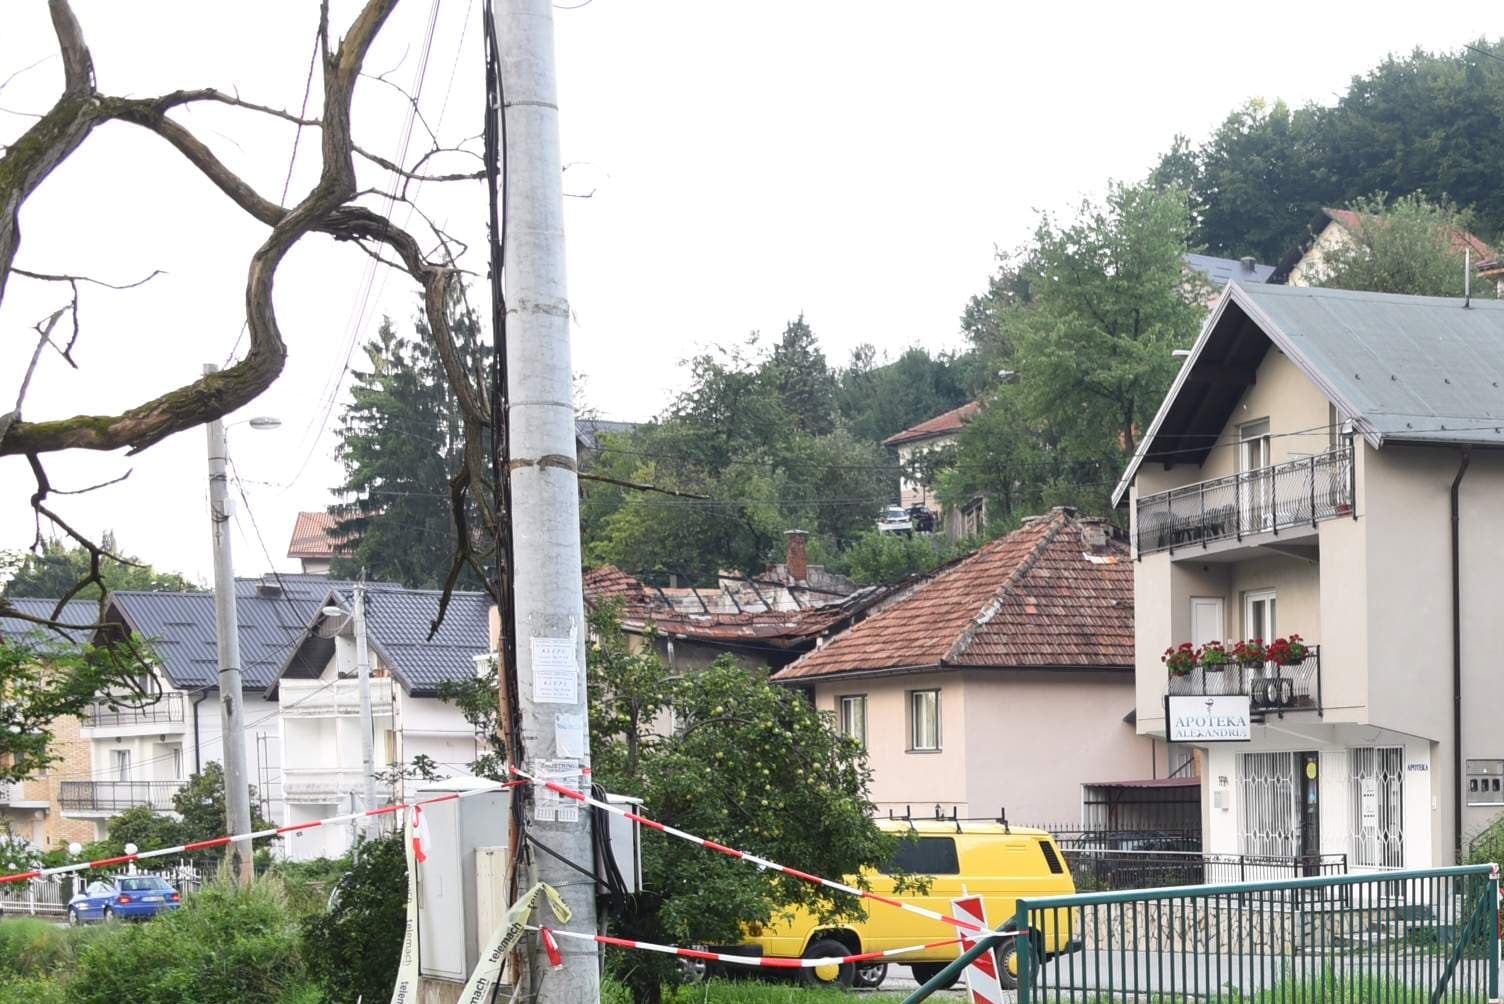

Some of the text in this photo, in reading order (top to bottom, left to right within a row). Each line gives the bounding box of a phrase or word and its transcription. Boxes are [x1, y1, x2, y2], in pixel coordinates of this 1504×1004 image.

[1176, 717, 1246, 728] APOTEKA
[1176, 728, 1247, 738] ALEXANDRI
[405, 918, 413, 967] telemach
[488, 922, 521, 963] telemach
